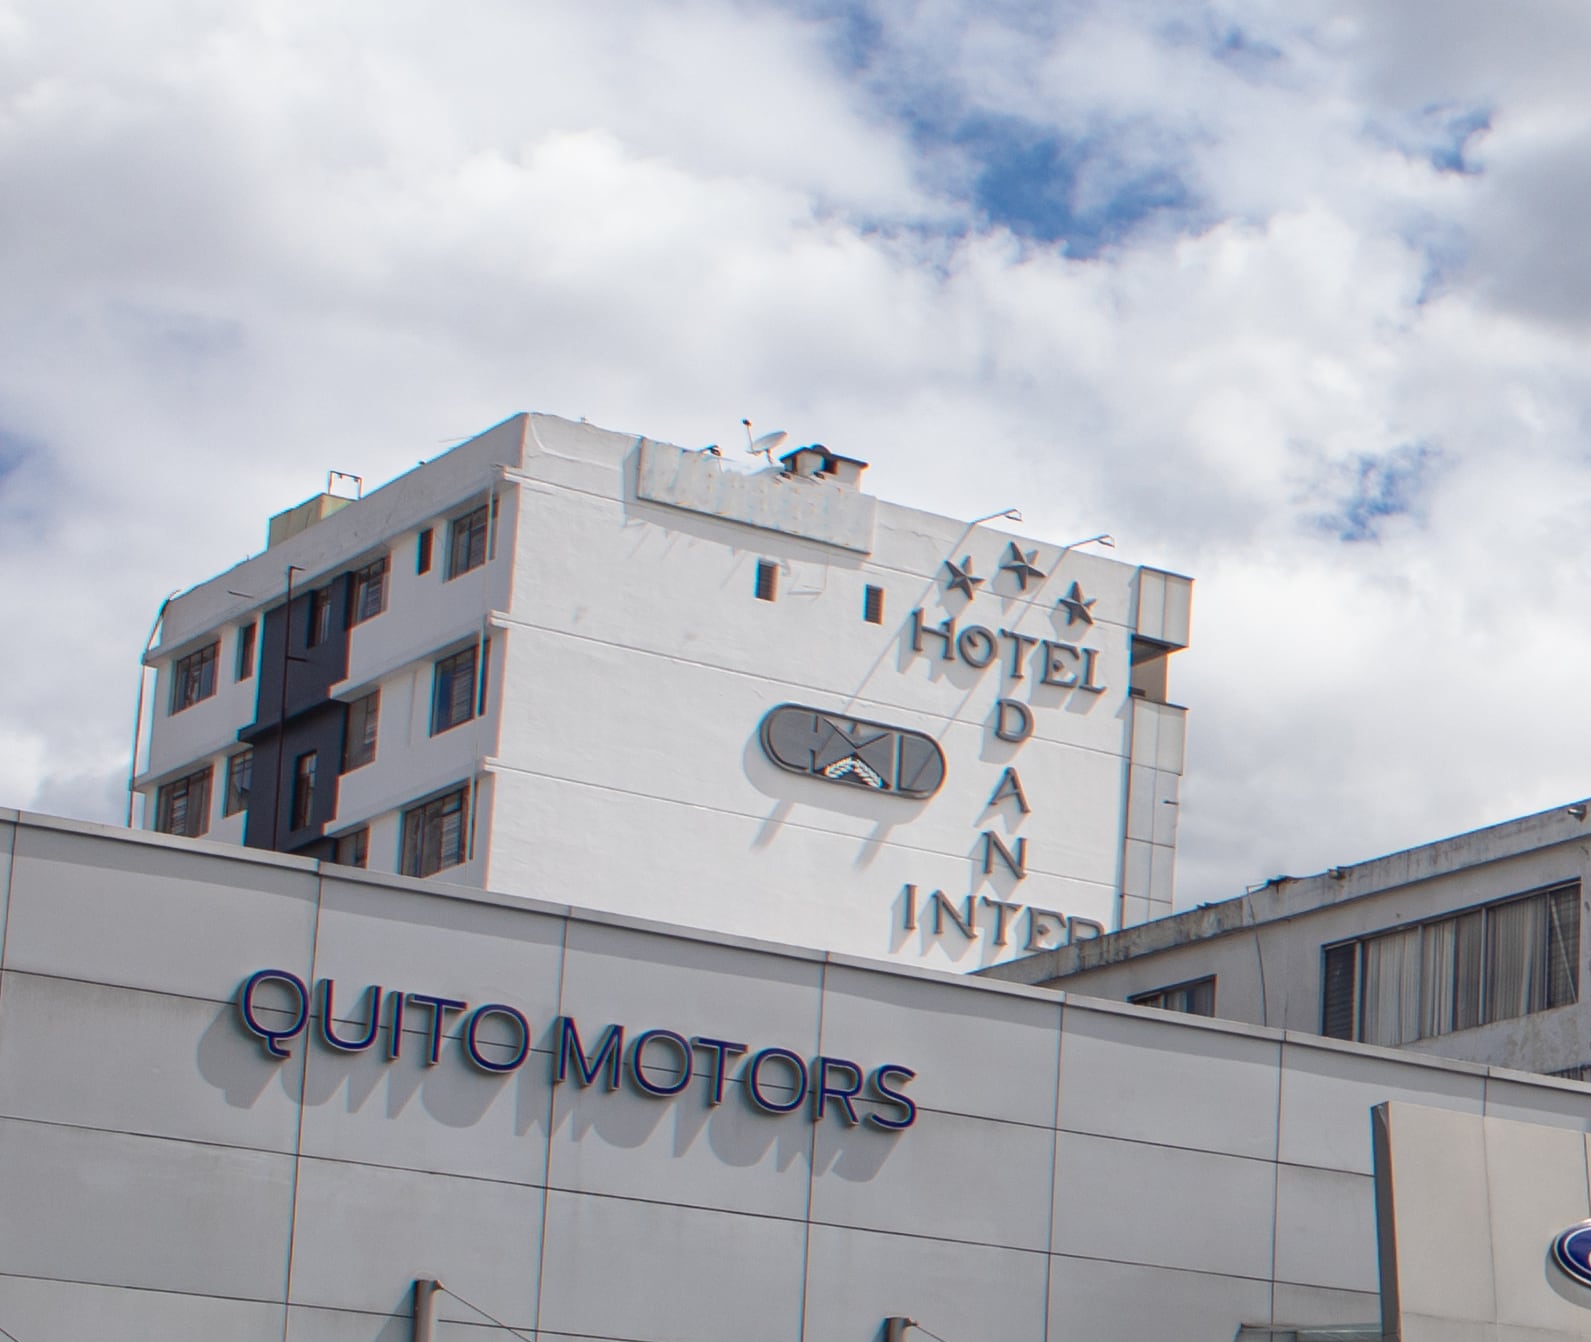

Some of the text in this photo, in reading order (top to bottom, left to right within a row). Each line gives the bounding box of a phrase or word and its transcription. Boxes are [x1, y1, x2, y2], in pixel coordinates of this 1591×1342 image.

[911, 608, 1107, 694] HOTEL
[239, 968, 918, 1131] QUITO MOTORS
